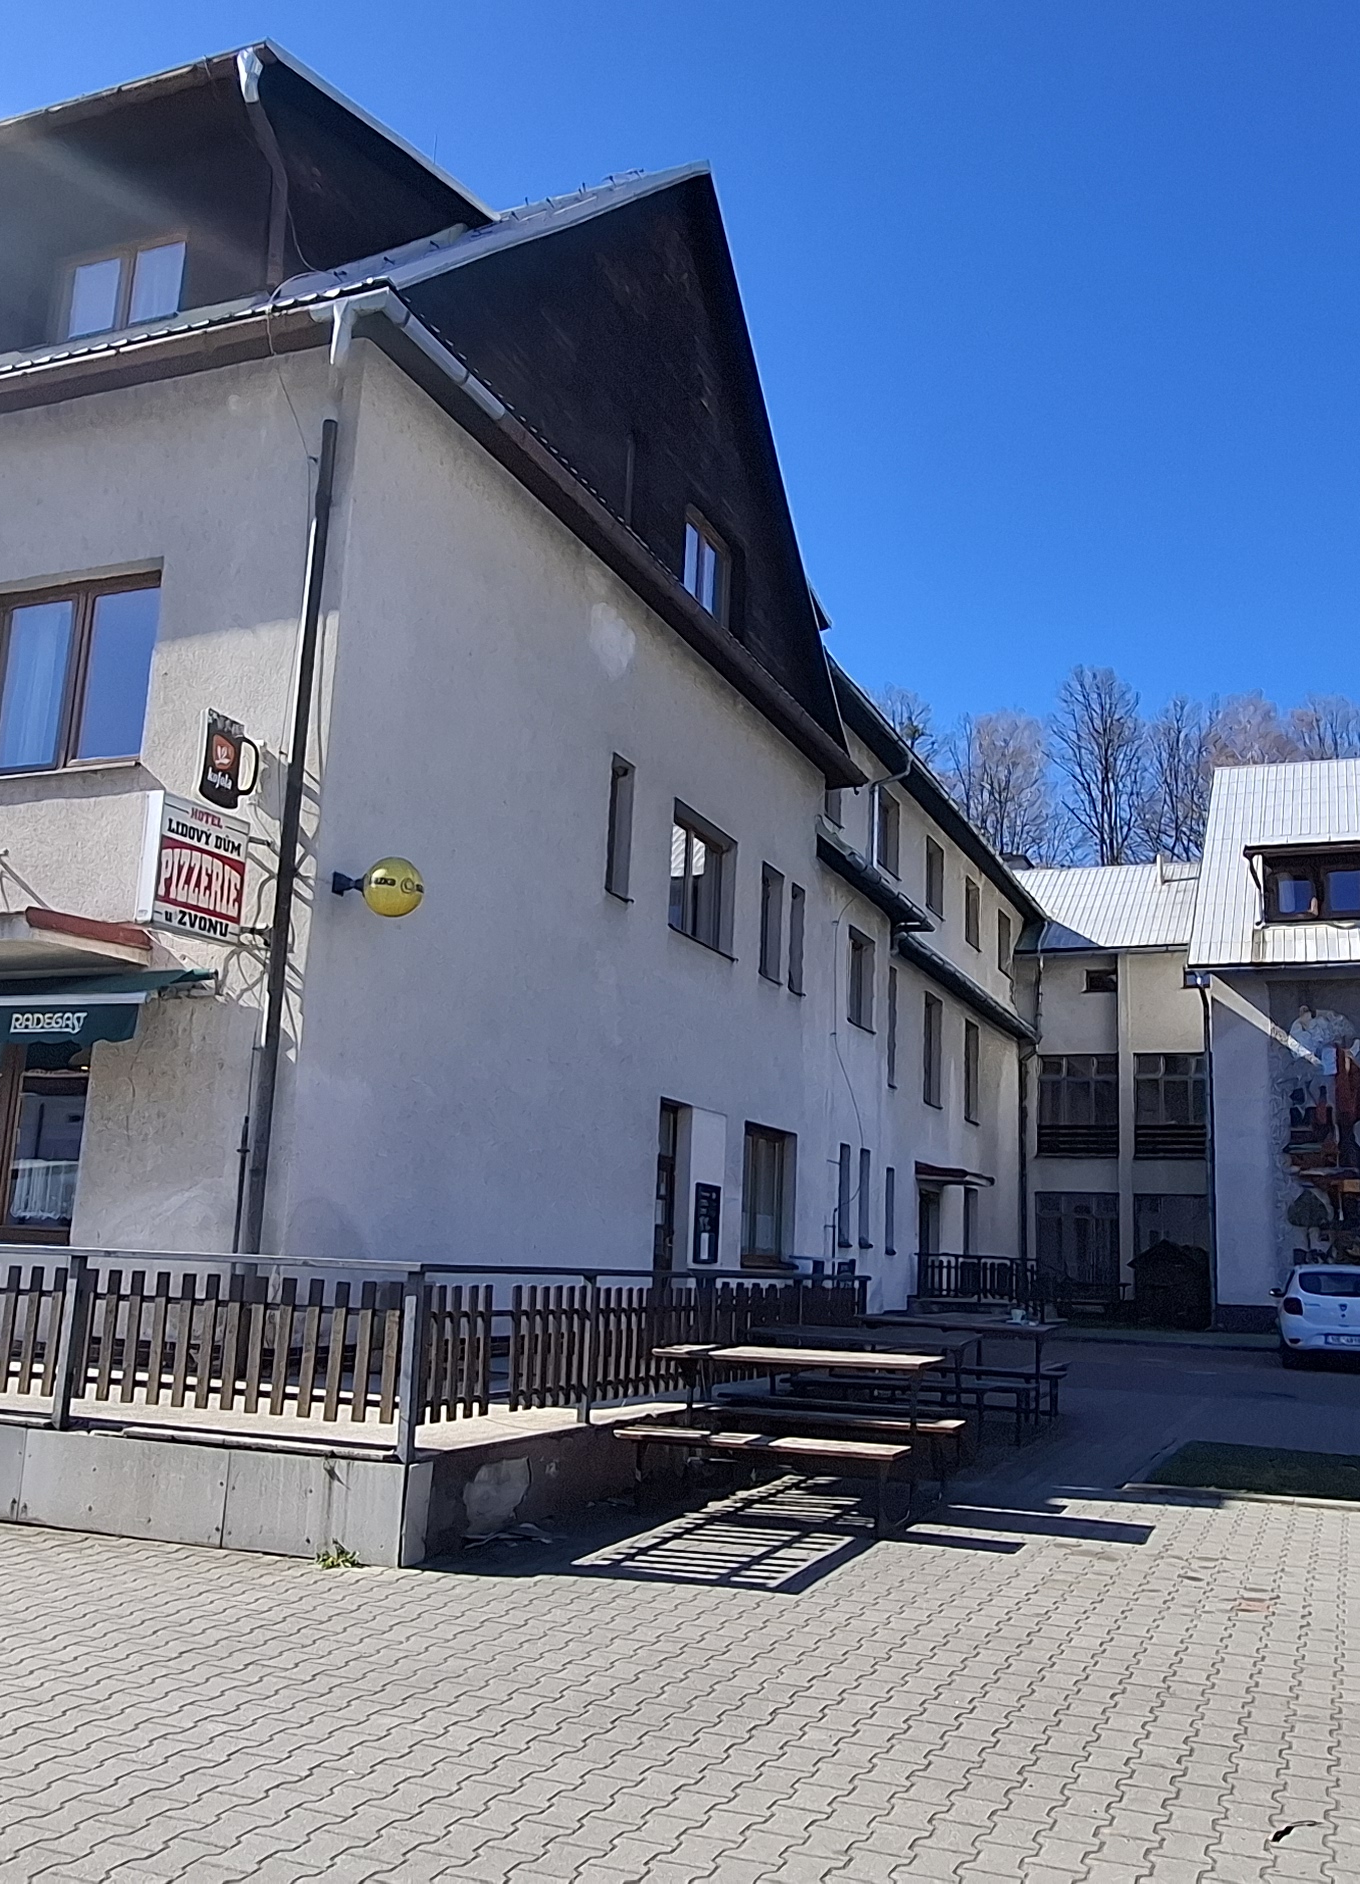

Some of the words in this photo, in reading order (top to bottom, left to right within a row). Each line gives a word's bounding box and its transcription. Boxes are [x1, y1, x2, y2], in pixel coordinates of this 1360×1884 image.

[207, 767, 232, 790] kofola
[190, 807, 223, 829] HOTEL
[167, 818, 212, 846] LIDOVÝ
[214, 834, 242, 857] DŮM
[159, 848, 240, 918] PIZZERIE
[177, 910, 229, 937] ZVONU
[10, 1012, 87, 1034] RADEGAST
